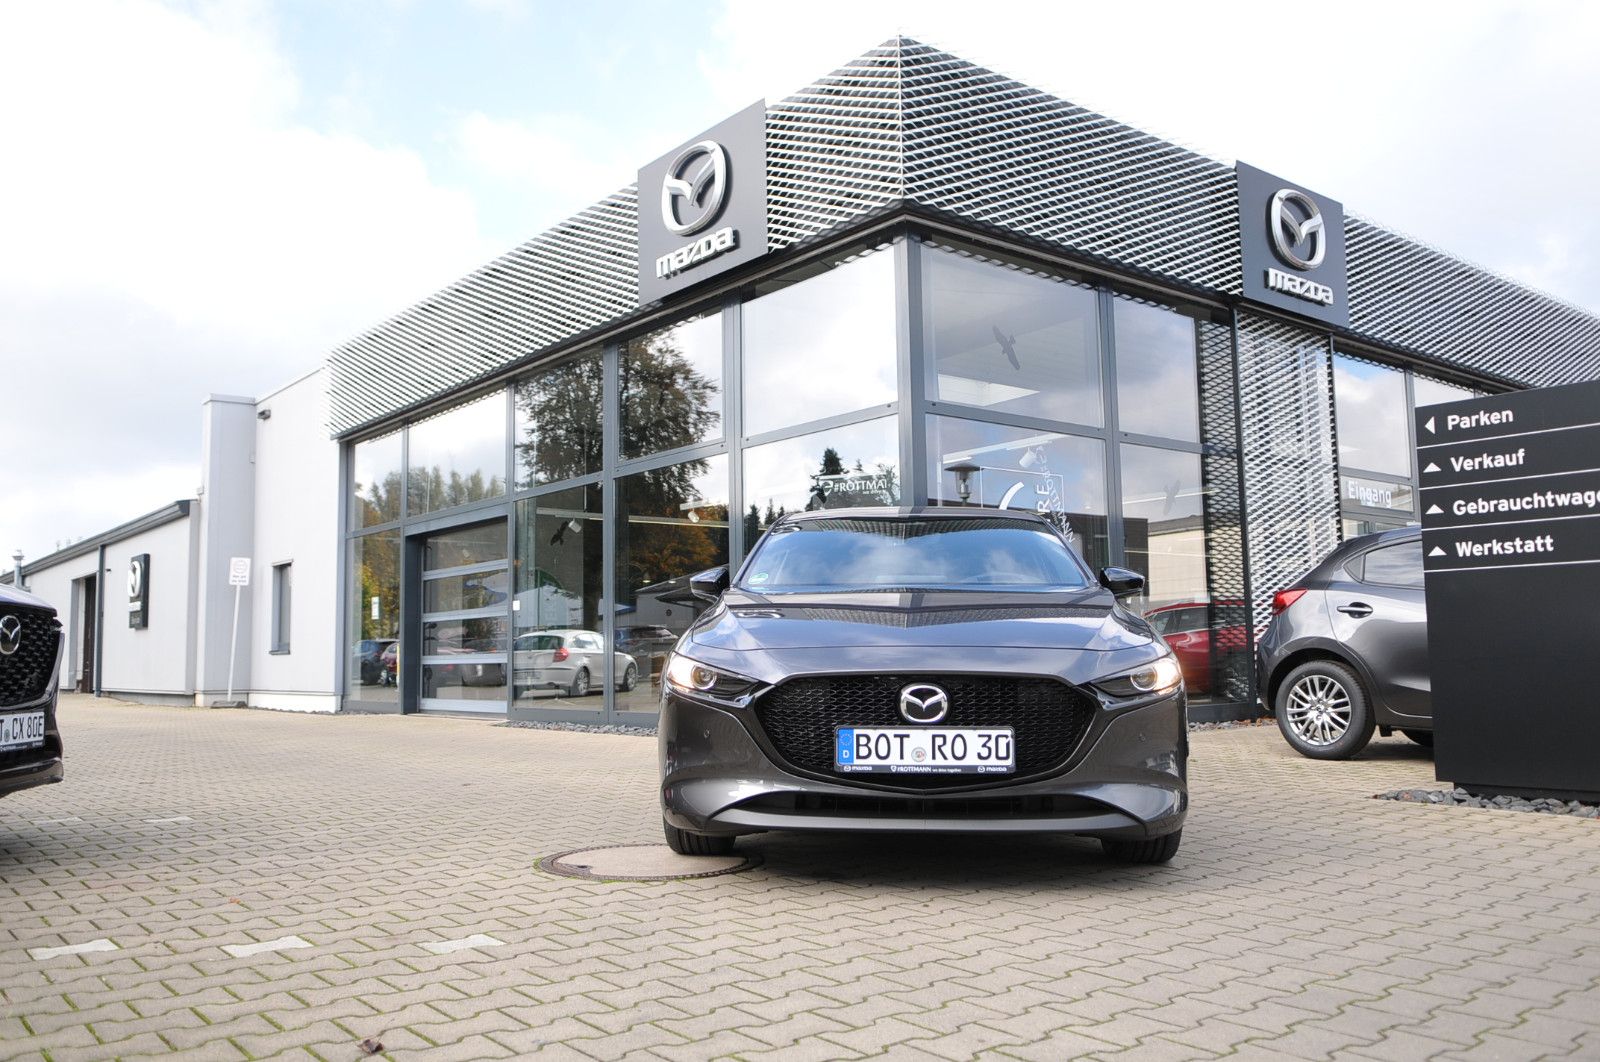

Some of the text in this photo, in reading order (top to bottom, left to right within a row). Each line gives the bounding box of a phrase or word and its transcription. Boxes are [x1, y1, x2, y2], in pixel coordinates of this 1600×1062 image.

[1447, 408, 1514, 431] Parken
[1450, 448, 1526, 472] Verkauf
[1348, 480, 1392, 509] Eingang
[1455, 534, 1554, 557] Werkstatt
[12, 717, 25, 740] CX
[842, 733, 1011, 761] D BOT RO 30
